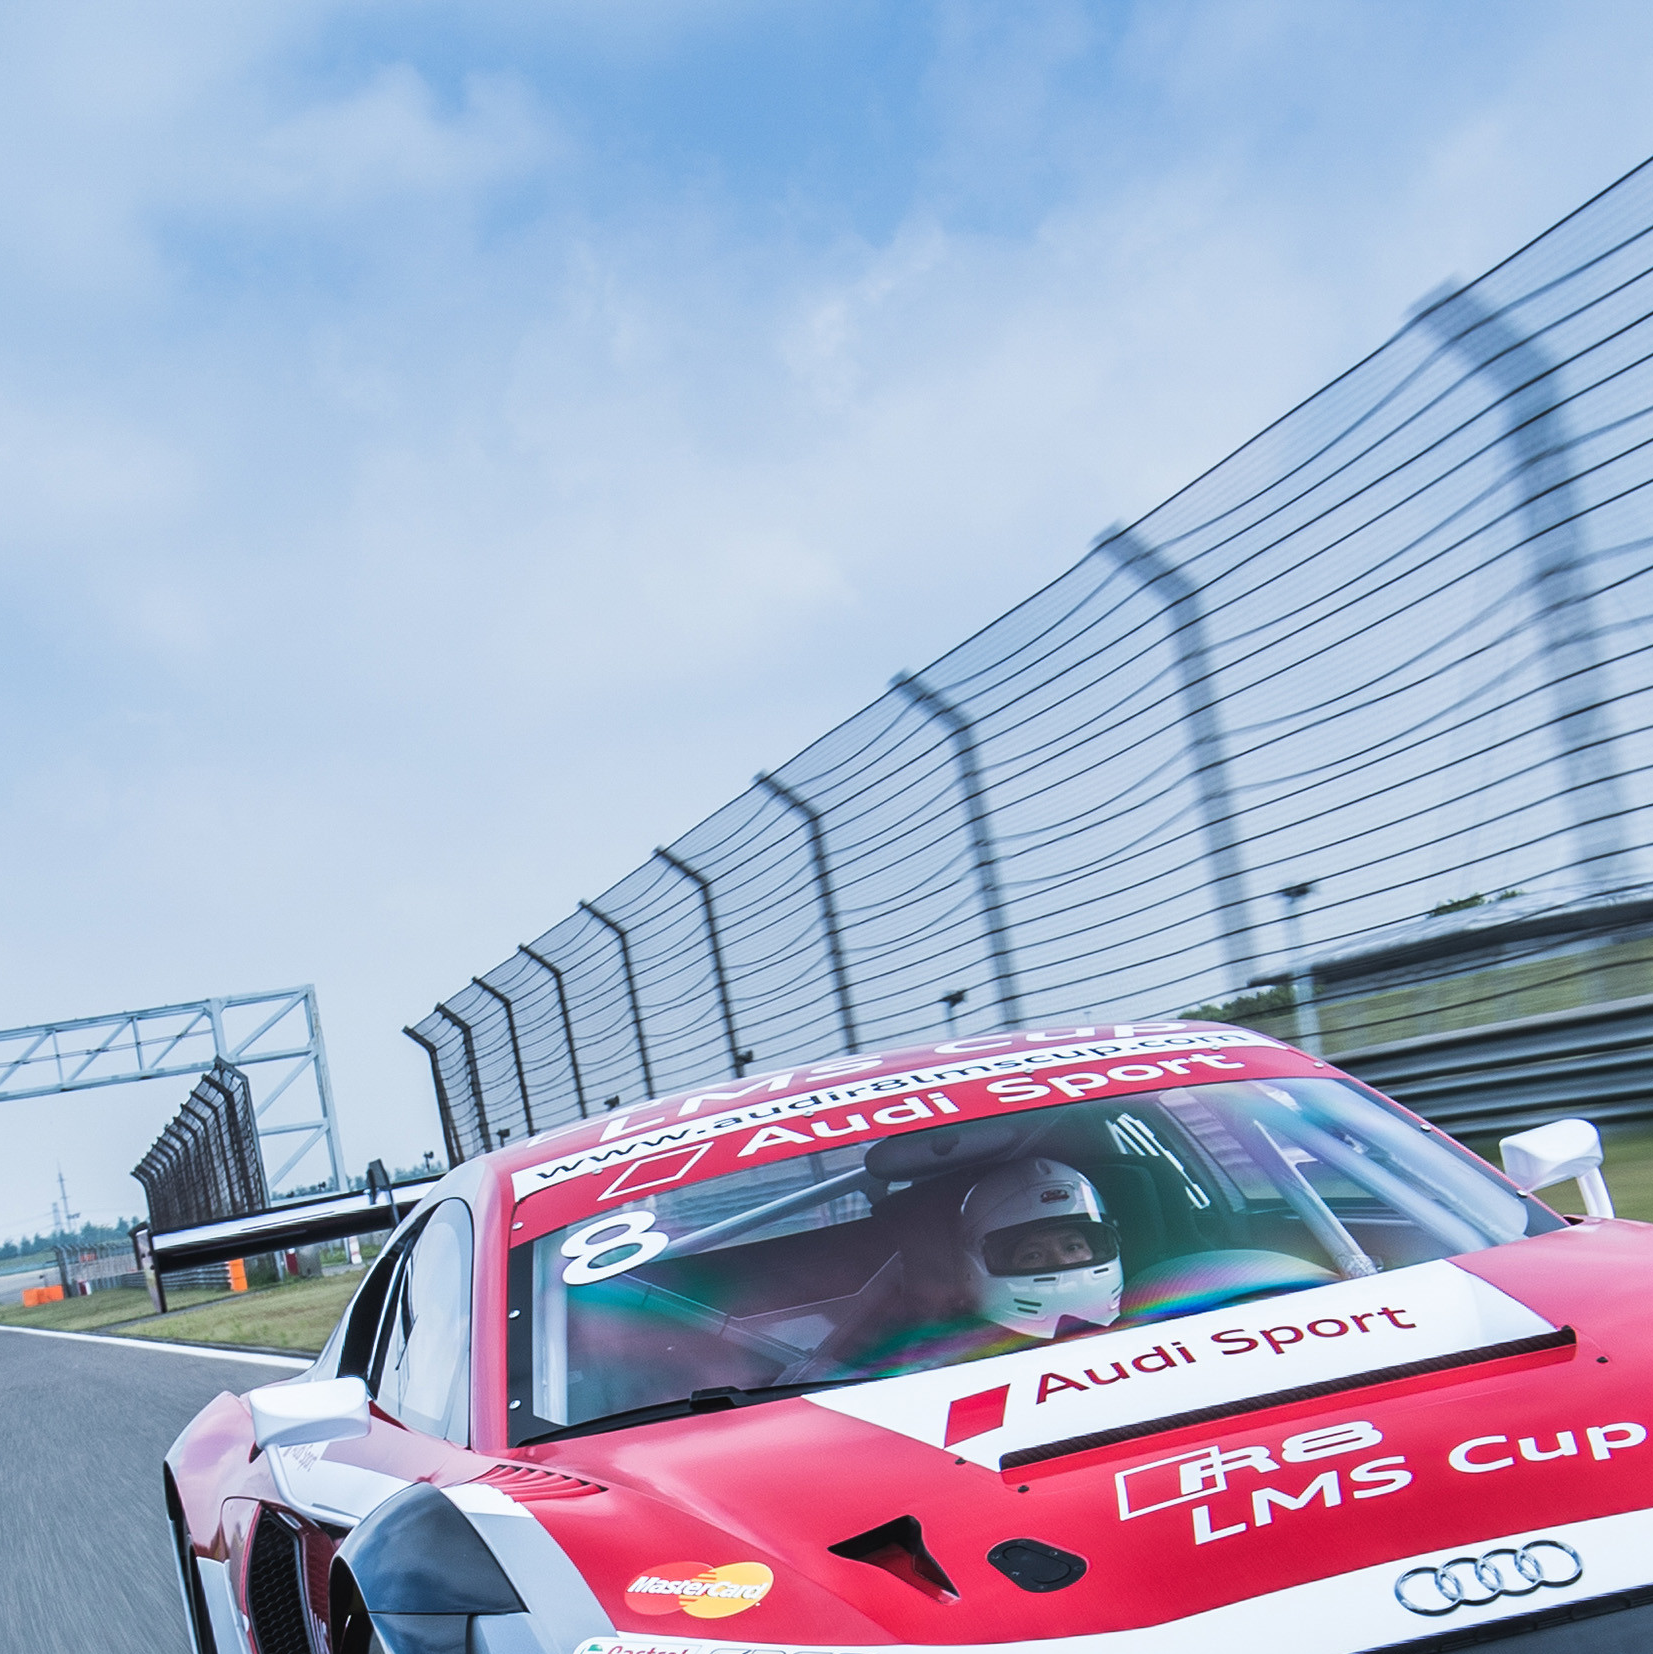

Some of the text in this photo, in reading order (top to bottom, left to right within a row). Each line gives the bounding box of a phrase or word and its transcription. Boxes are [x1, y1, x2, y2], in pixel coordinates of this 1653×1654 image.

[537, 1034, 1248, 1179] www.audir8lmscup.com
[599, 1055, 884, 1142] LMS
[933, 1021, 1188, 1055] Cup
[737, 1091, 960, 1158] Audi
[986, 1052, 1246, 1104] Sport
[560, 1210, 669, 1286] 8
[1034, 1305, 1418, 1404] Audi Sport
[1180, 1420, 1383, 1496] R8
[1191, 1421, 1648, 1545] LMS Cup
[626, 1575, 770, 1600] MasterCard
